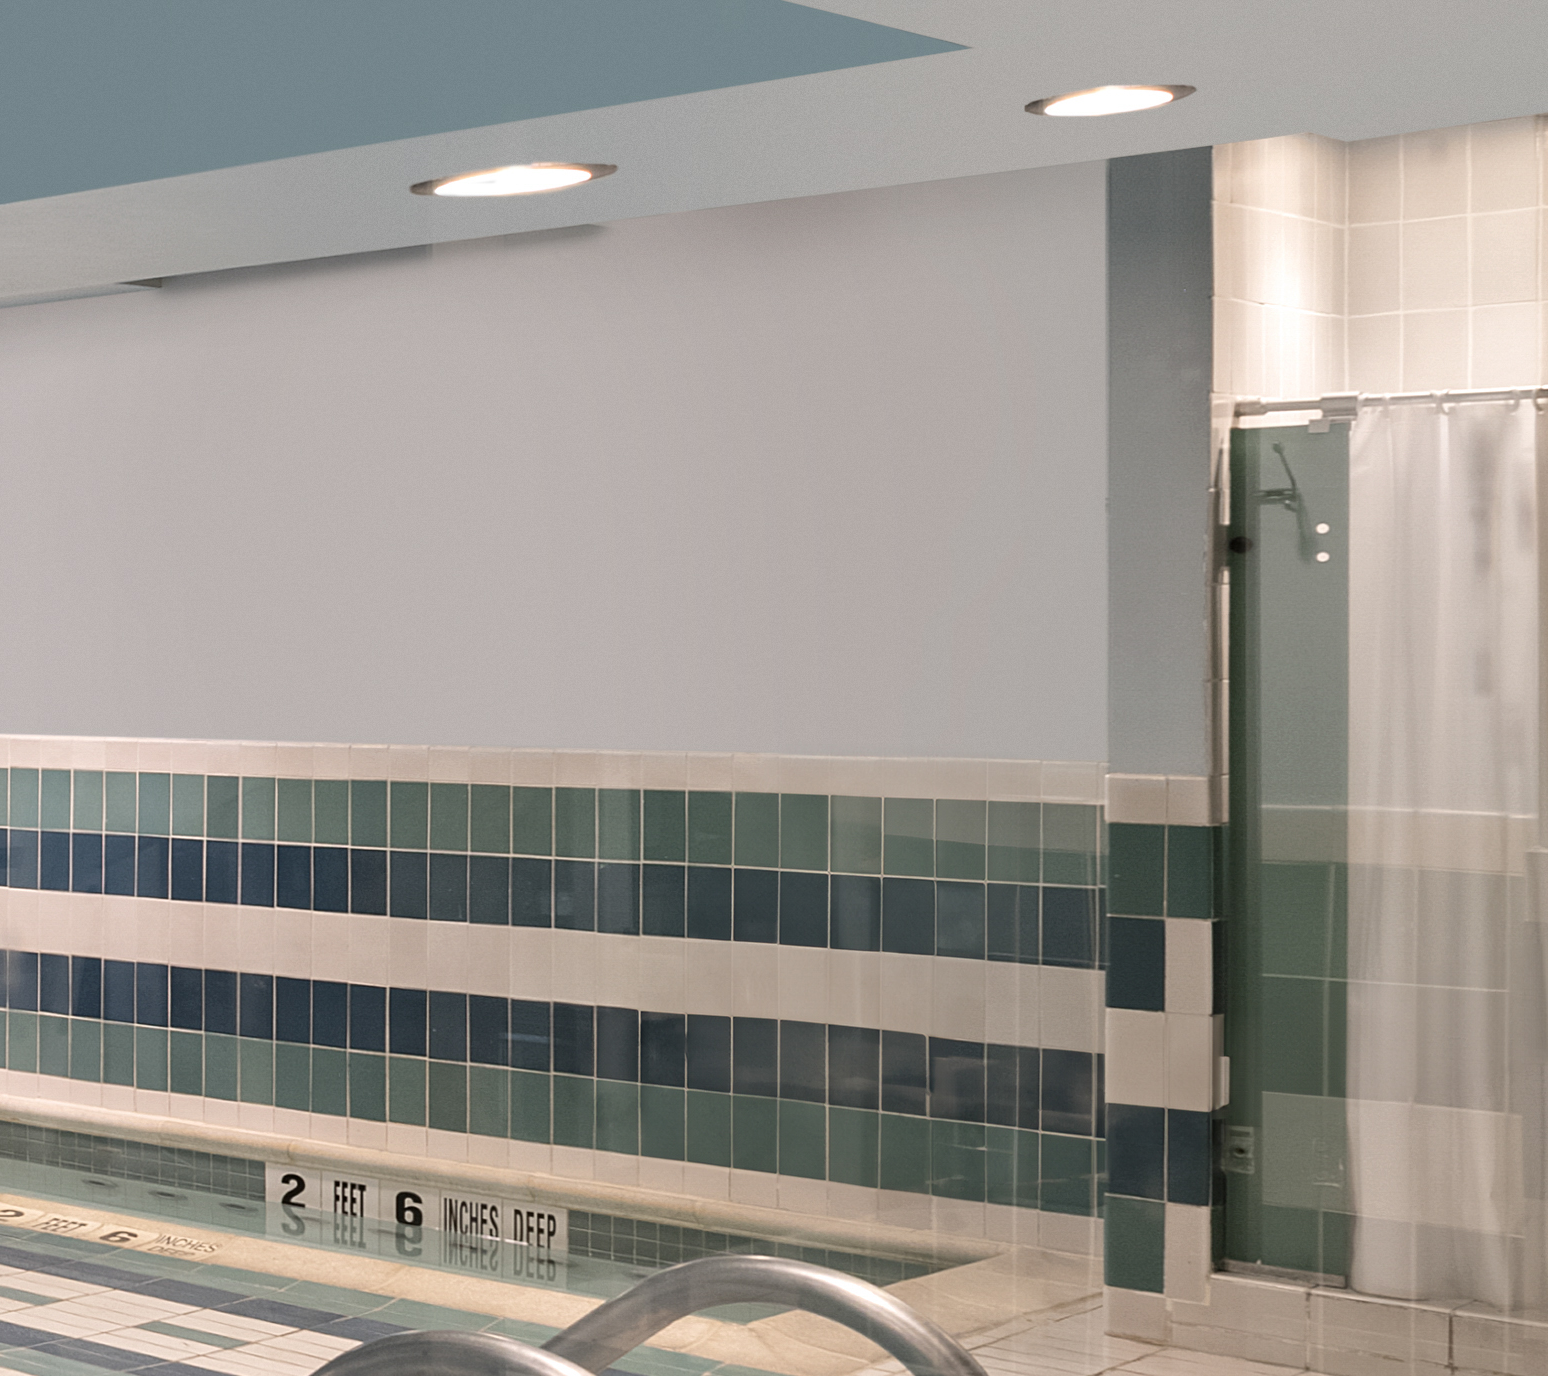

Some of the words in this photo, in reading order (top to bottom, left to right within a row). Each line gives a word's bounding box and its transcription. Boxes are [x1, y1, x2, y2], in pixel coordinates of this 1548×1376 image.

[281, 1174, 306, 1208] 2
[334, 1180, 367, 1218] FEET
[396, 1191, 424, 1226] 6
[444, 1197, 500, 1241] INCHES
[513, 1209, 556, 1250] DEEP
[34, 1218, 88, 1234] FEET
[99, 1231, 139, 1244] 6
[156, 1234, 223, 1254] INCHES
[148, 1245, 197, 1258] DEEP
